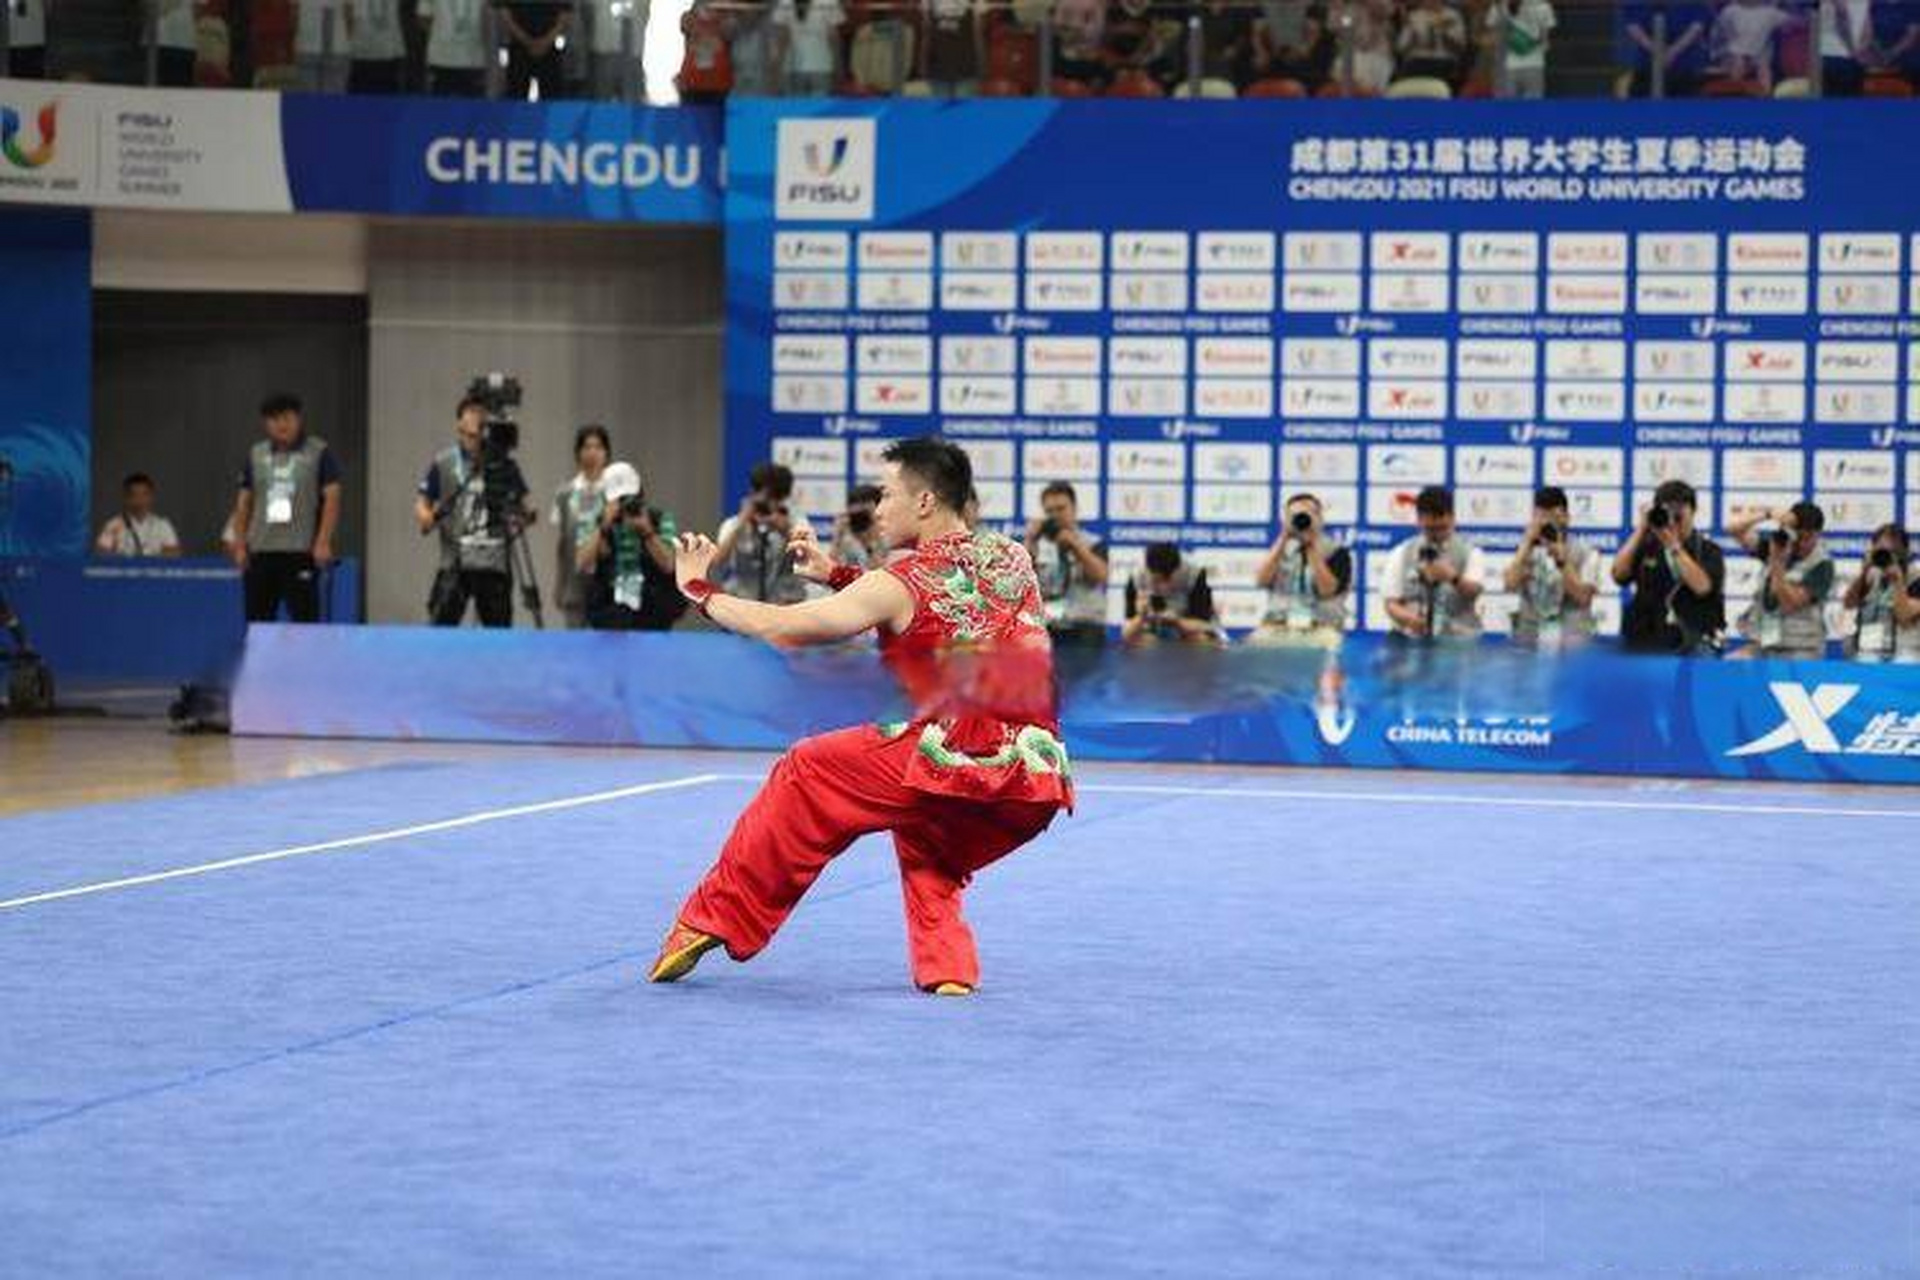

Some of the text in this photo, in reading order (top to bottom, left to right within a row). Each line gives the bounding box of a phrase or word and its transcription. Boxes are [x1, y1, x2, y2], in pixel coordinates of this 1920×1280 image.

[426, 137, 701, 188] CHENGDU
[787, 184, 861, 204] FISU
[1288, 177, 1804, 200] CHENGDU 2021 FISU WORLD UNIVERSITY GAMES
[1386, 726, 1551, 745] CHINA TELECOM
